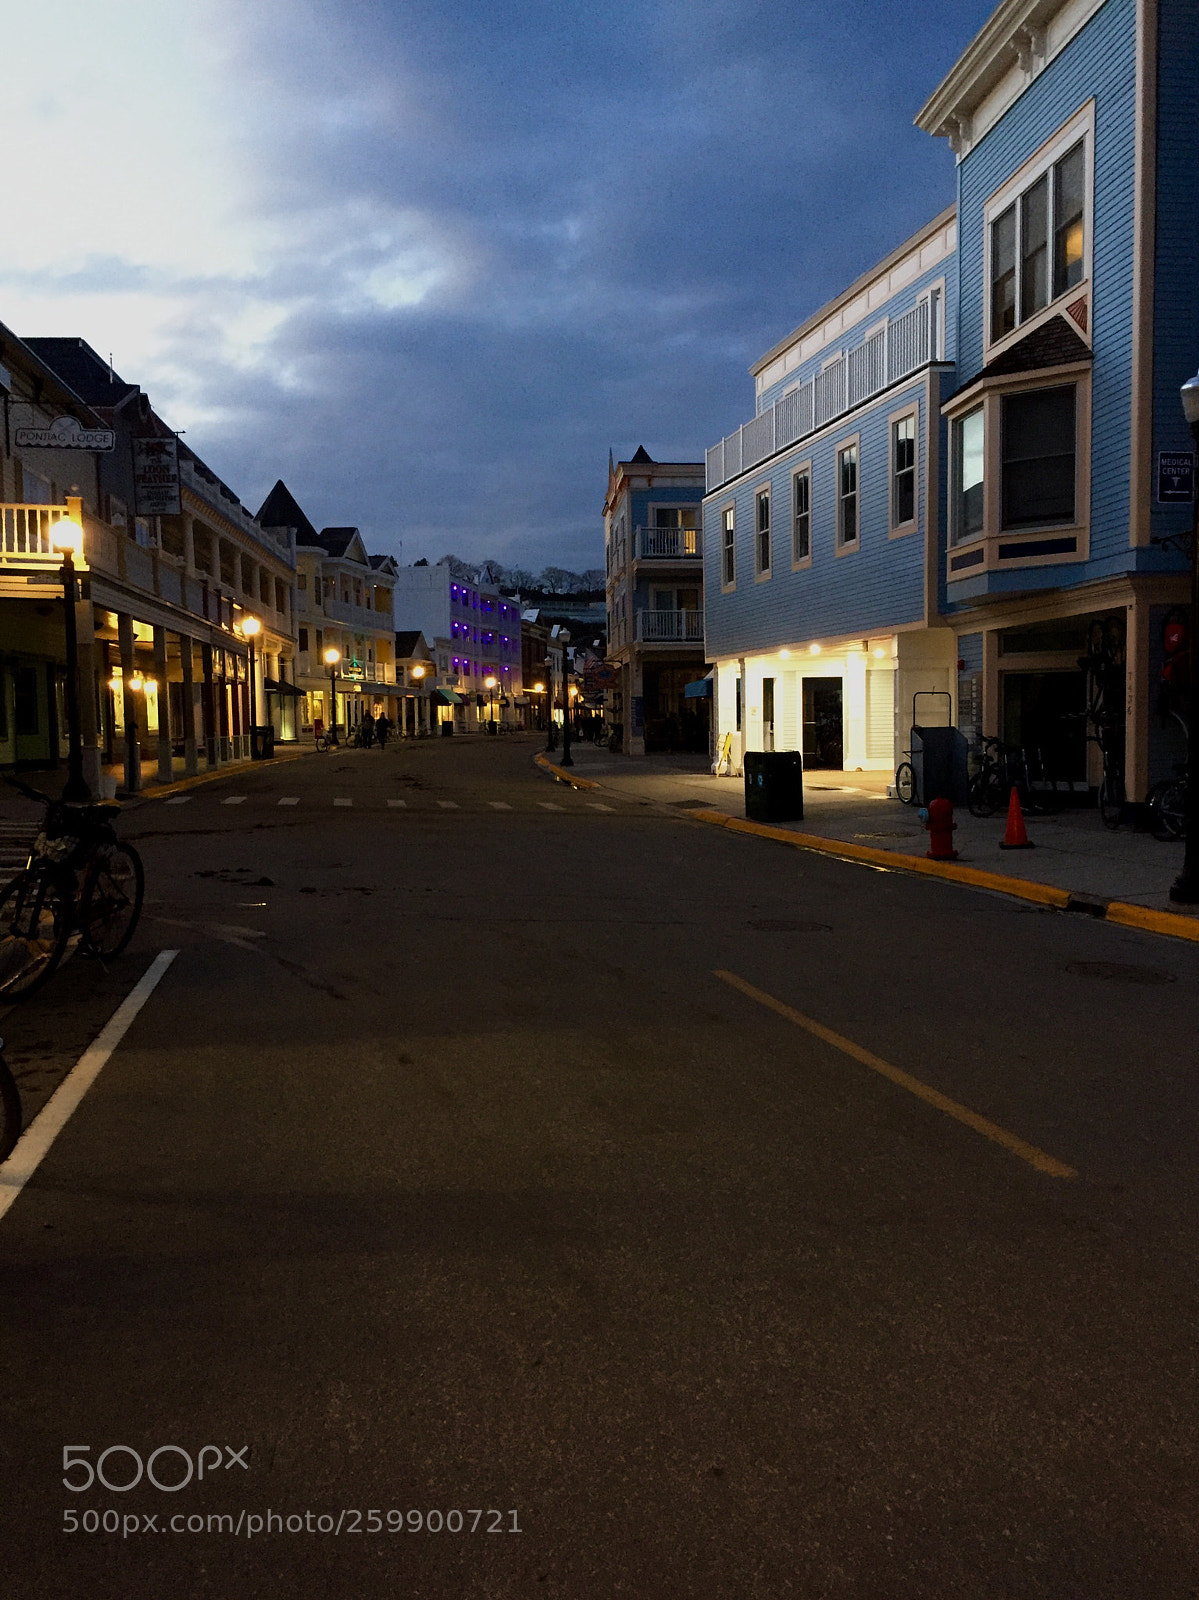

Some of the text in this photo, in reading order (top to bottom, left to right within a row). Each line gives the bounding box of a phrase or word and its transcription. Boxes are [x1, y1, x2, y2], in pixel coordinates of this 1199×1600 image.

[20, 431, 111, 443] PONTIAC LODGE
[1161, 458, 1193, 466] MEDICAL
[1162, 467, 1190, 475] CENTER
